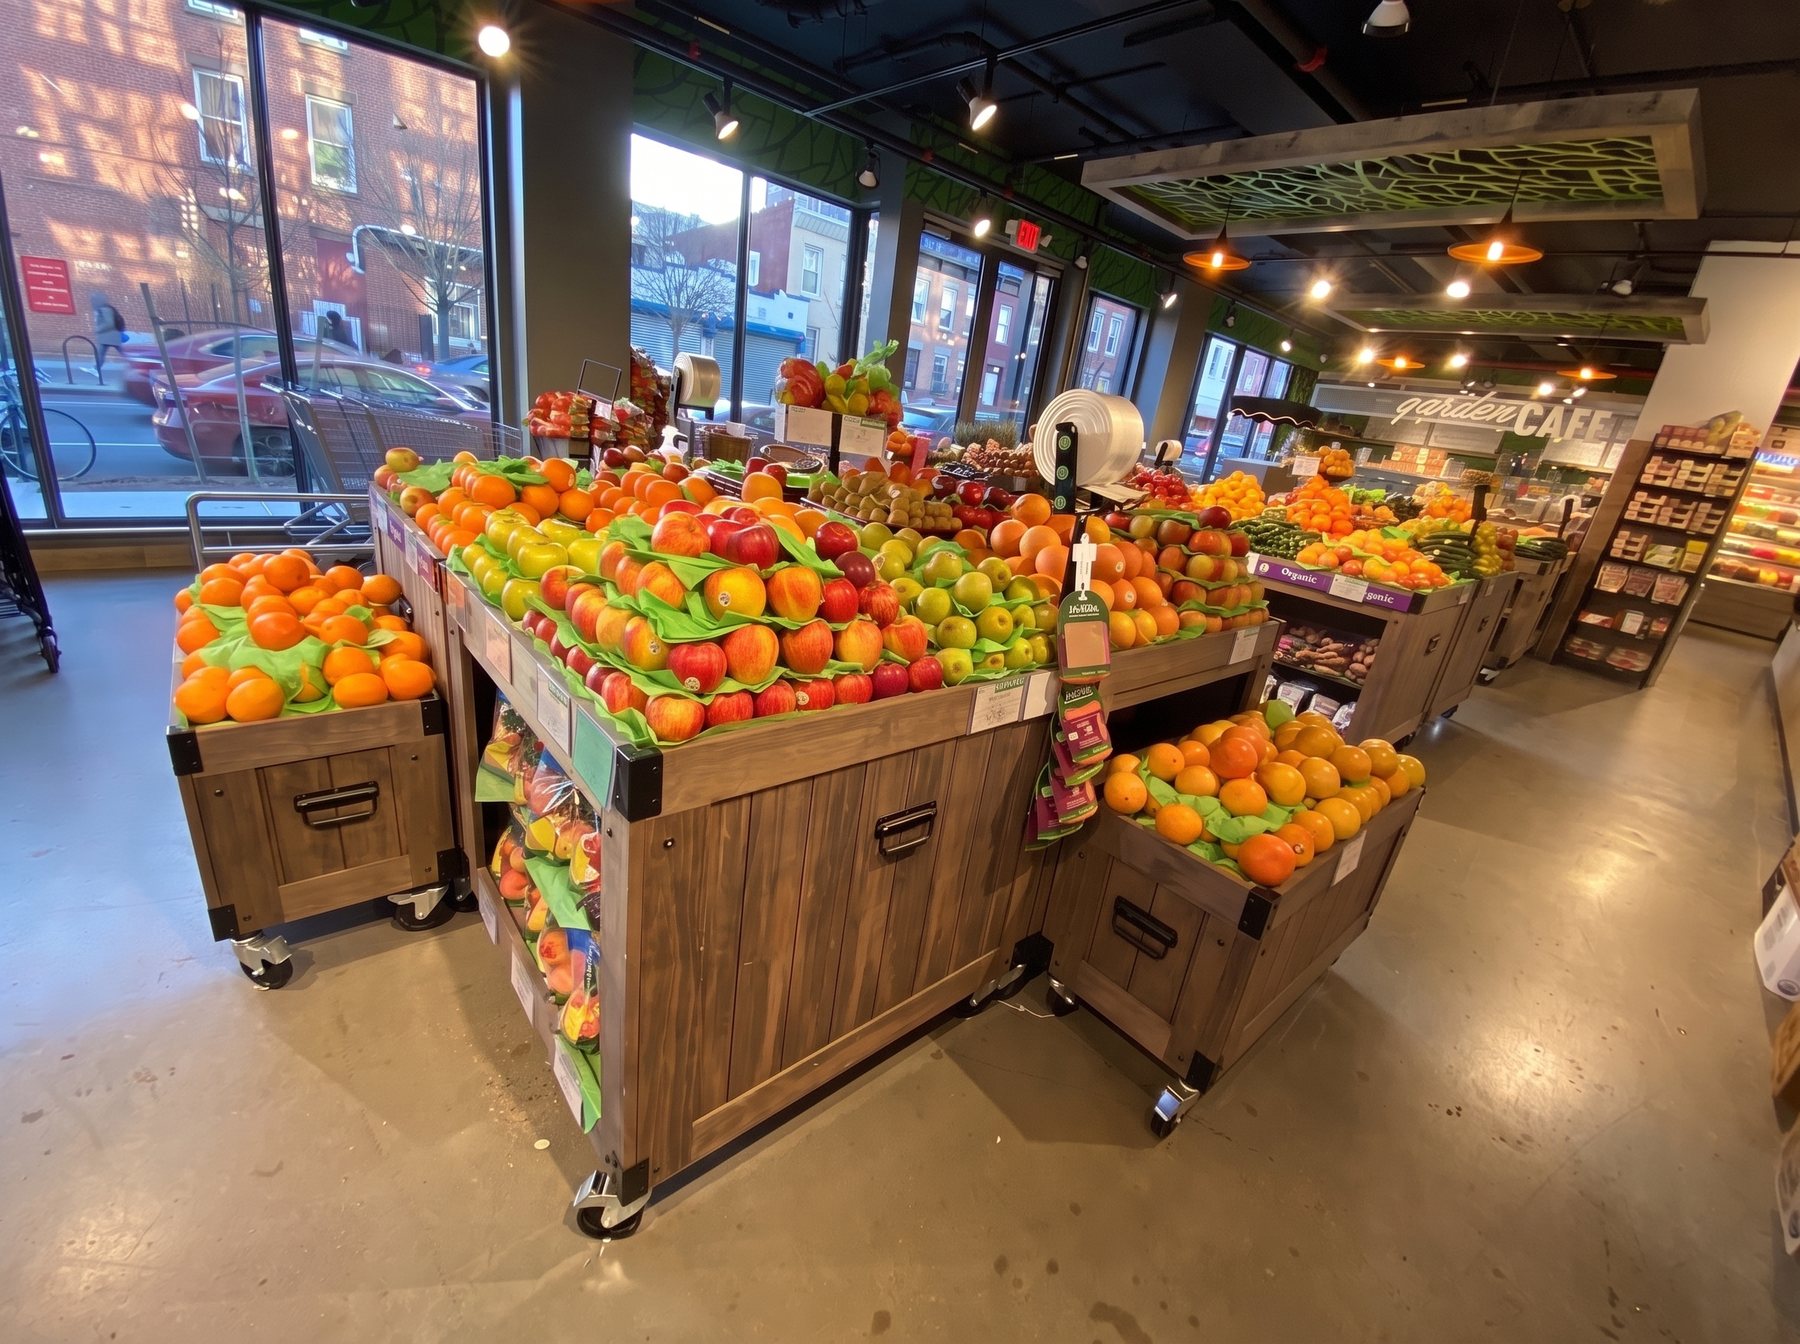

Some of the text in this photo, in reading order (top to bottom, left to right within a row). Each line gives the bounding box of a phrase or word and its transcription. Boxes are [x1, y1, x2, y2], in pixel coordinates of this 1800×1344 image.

[1018, 221, 1039, 251] EXIT
[1391, 391, 1612, 443] garden CAFE
[1281, 567, 1318, 584] Organic
